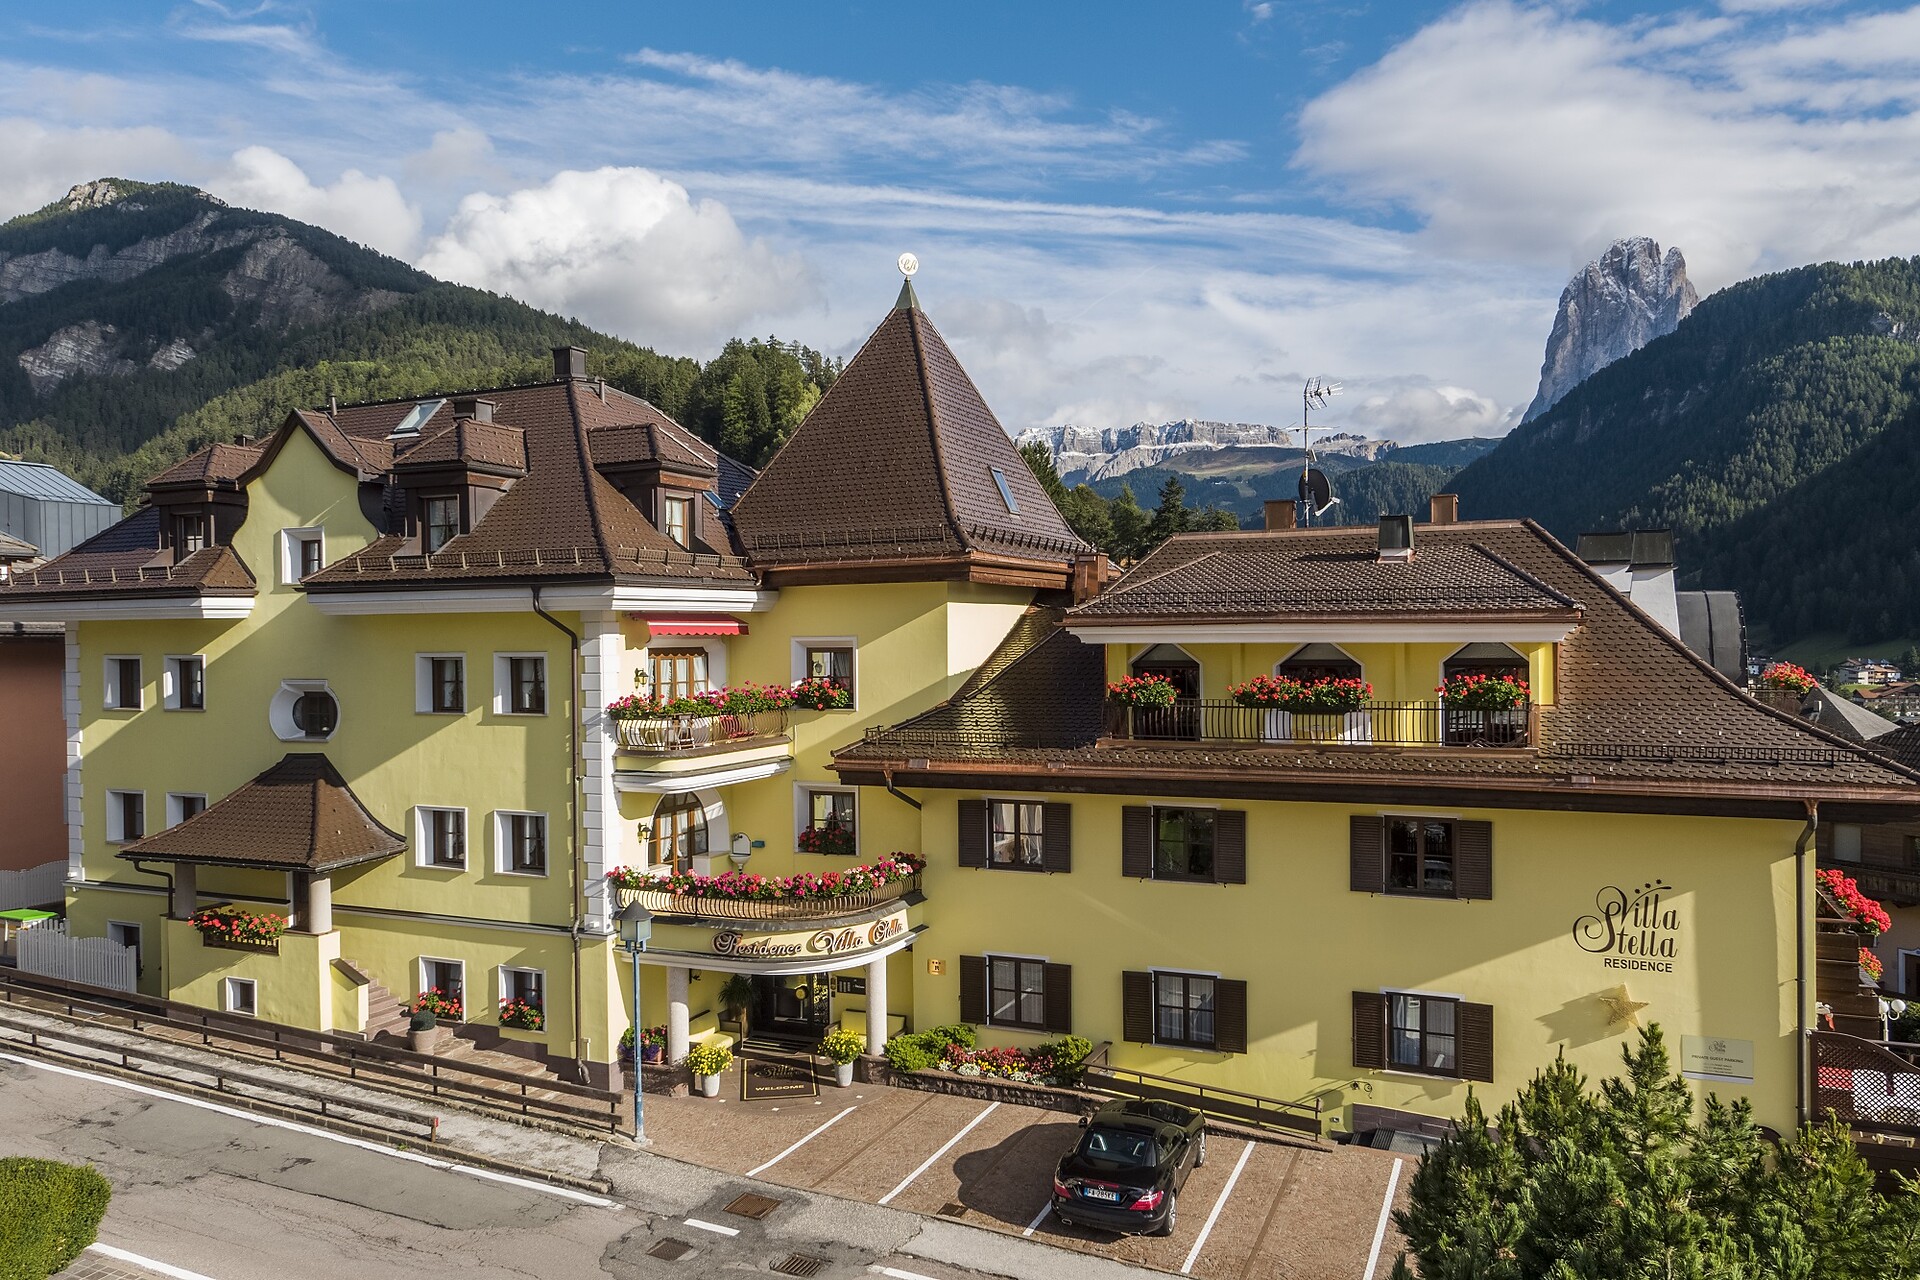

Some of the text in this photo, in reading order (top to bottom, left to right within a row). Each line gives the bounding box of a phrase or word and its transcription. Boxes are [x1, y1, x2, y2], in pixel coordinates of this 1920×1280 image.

[1596, 885, 1680, 930] Villa
[712, 930, 801, 957] Residence
[807, 928, 864, 954] Villa
[1572, 901, 1678, 958] Stella
[1604, 958, 1673, 973] RESIDENCE
